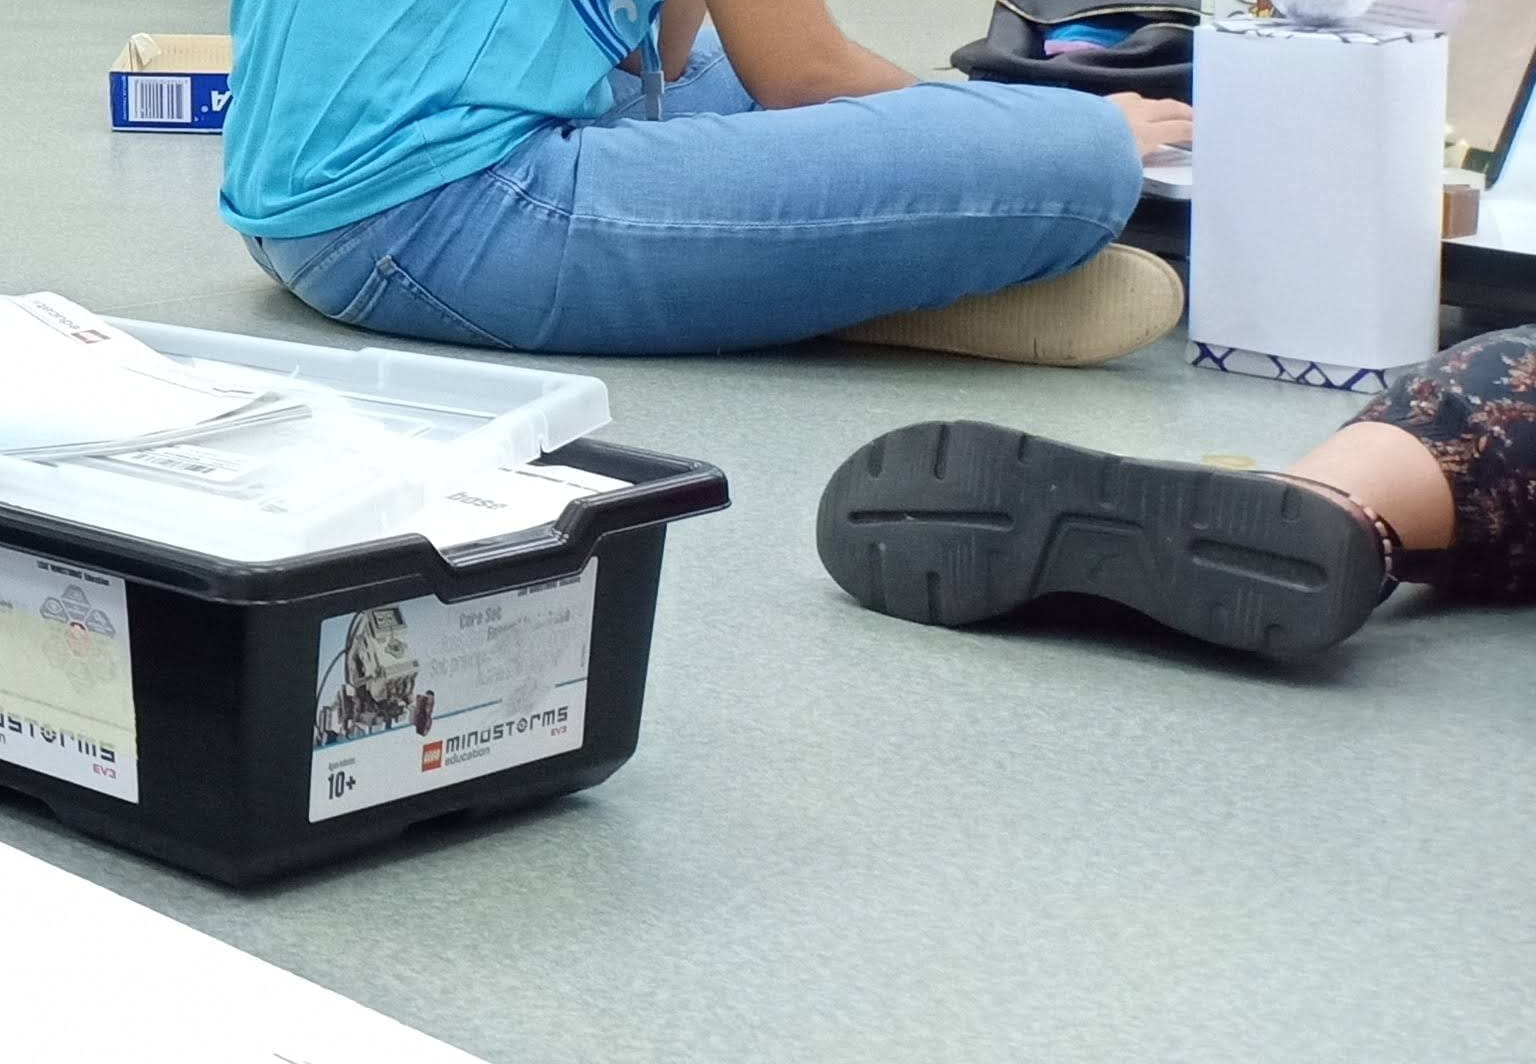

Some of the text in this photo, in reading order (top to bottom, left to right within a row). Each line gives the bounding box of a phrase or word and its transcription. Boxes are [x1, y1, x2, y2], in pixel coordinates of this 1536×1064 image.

[445, 746, 490, 768] education
[92, 762, 117, 779] EV3
[328, 770, 356, 801] 10+
